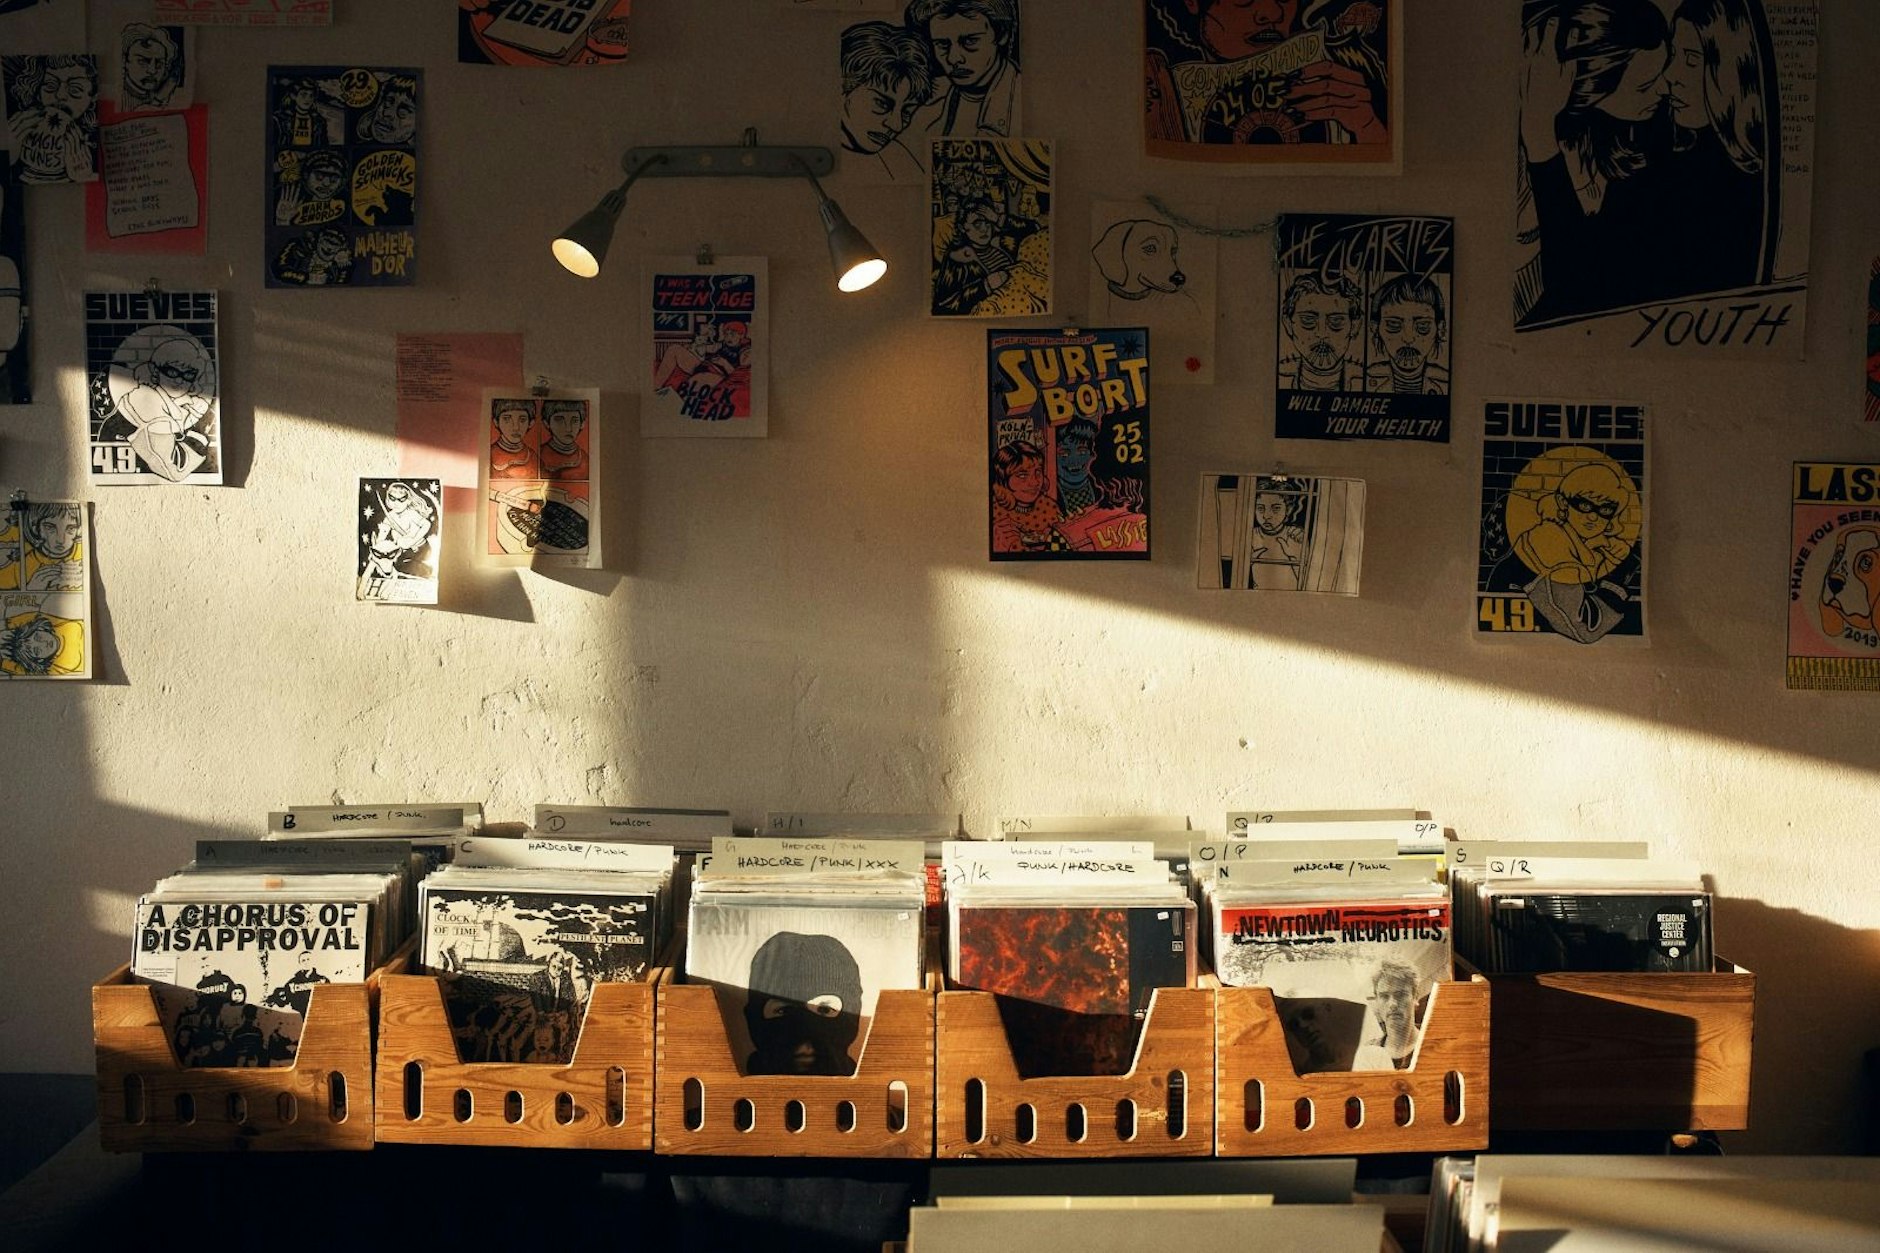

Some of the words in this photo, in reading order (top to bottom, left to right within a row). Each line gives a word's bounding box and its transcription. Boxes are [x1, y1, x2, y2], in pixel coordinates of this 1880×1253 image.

[505, 0, 587, 34] DEAD
[1250, 34, 1320, 78] ISLAND
[341, 71, 370, 92] 29
[1213, 90, 1245, 128] 24
[1251, 80, 1287, 110] 05
[25, 131, 64, 150] MAGIC
[22, 146, 62, 168] TUNES
[357, 153, 404, 177] GOLDEN
[354, 165, 415, 190] SCHMUCKS
[299, 204, 344, 223] SWORDS
[300, 201, 332, 214] WARM
[353, 230, 415, 259] MALHEUR
[1277, 220, 1330, 274] THE
[1320, 216, 1453, 289] CIGARETTES
[370, 253, 406, 276] D'OR
[667, 278, 690, 288] WAS
[86, 292, 212, 320] SUEVES
[656, 290, 711, 307] TEEN
[716, 290, 754, 307] AGE
[1630, 302, 1793, 348] YOUTH
[997, 342, 1119, 416] SURF
[676, 379, 736, 404] BLOCK
[1042, 357, 1149, 428] BORT
[680, 398, 736, 421] HEAD
[1288, 395, 1321, 412] WILL
[1330, 397, 1392, 415] DAMAGE
[1324, 416, 1370, 435] YOUR
[1374, 418, 1443, 437] HEALTH
[1484, 402, 1639, 439] SUEVES
[999, 429, 1033, 442] PRIVAT
[1111, 420, 1143, 444] 25
[1116, 444, 1145, 464] 02
[1797, 466, 1880, 501] LAS
[1790, 546, 1813, 590] HAVE
[1807, 520, 1835, 545] YOU
[1844, 626, 1877, 648] 2019
[283, 814, 296, 829] B
[459, 840, 473, 853] C
[1455, 847, 1467, 863] S
[701, 857, 713, 871] F
[1219, 866, 1229, 878] N
[146, 904, 167, 927] A
[180, 904, 306, 927] CHORUS
[319, 903, 358, 927] OF
[436, 913, 471, 923] CLOCK
[1239, 909, 1341, 938] NEWTOWN
[1656, 913, 1688, 923] REGIONAL
[434, 926, 448, 935] OF
[1660, 922, 1686, 931] JUSTICE
[1661, 930, 1685, 939] CENTER
[141, 928, 360, 952] DISAPPROVAL
[559, 933, 607, 944] PESTILENT
[609, 935, 644, 944] PLANET
